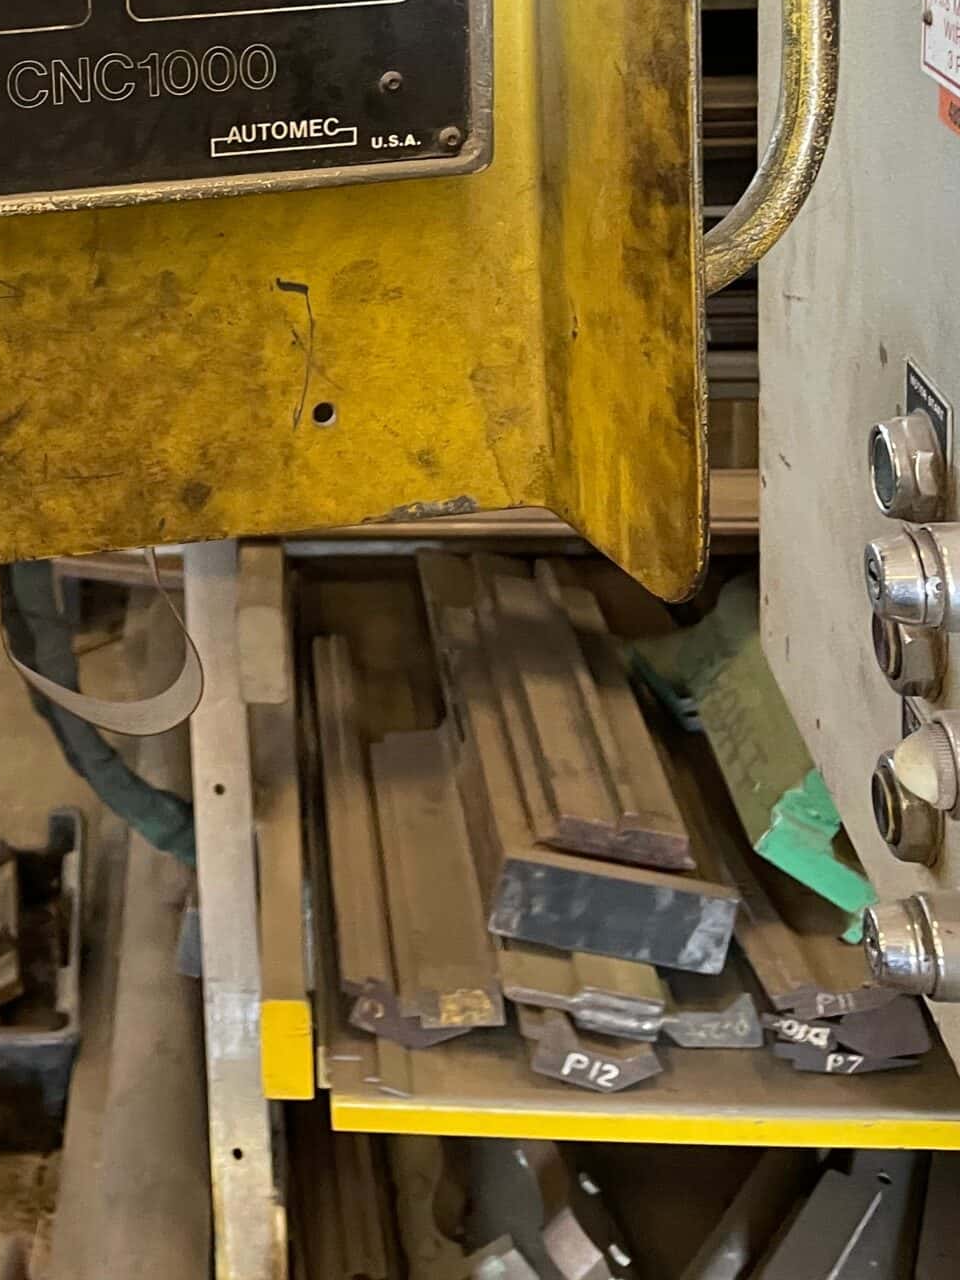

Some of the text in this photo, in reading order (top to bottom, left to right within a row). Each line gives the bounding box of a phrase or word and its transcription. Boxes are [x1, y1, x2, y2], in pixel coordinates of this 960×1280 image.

[7, 43, 277, 109] CNC1000
[226, 117, 341, 145] AUTOMEC
[371, 135, 421, 150] U.S.A.
[561, 1052, 620, 1088] P12
[826, 1053, 864, 1075] P7
